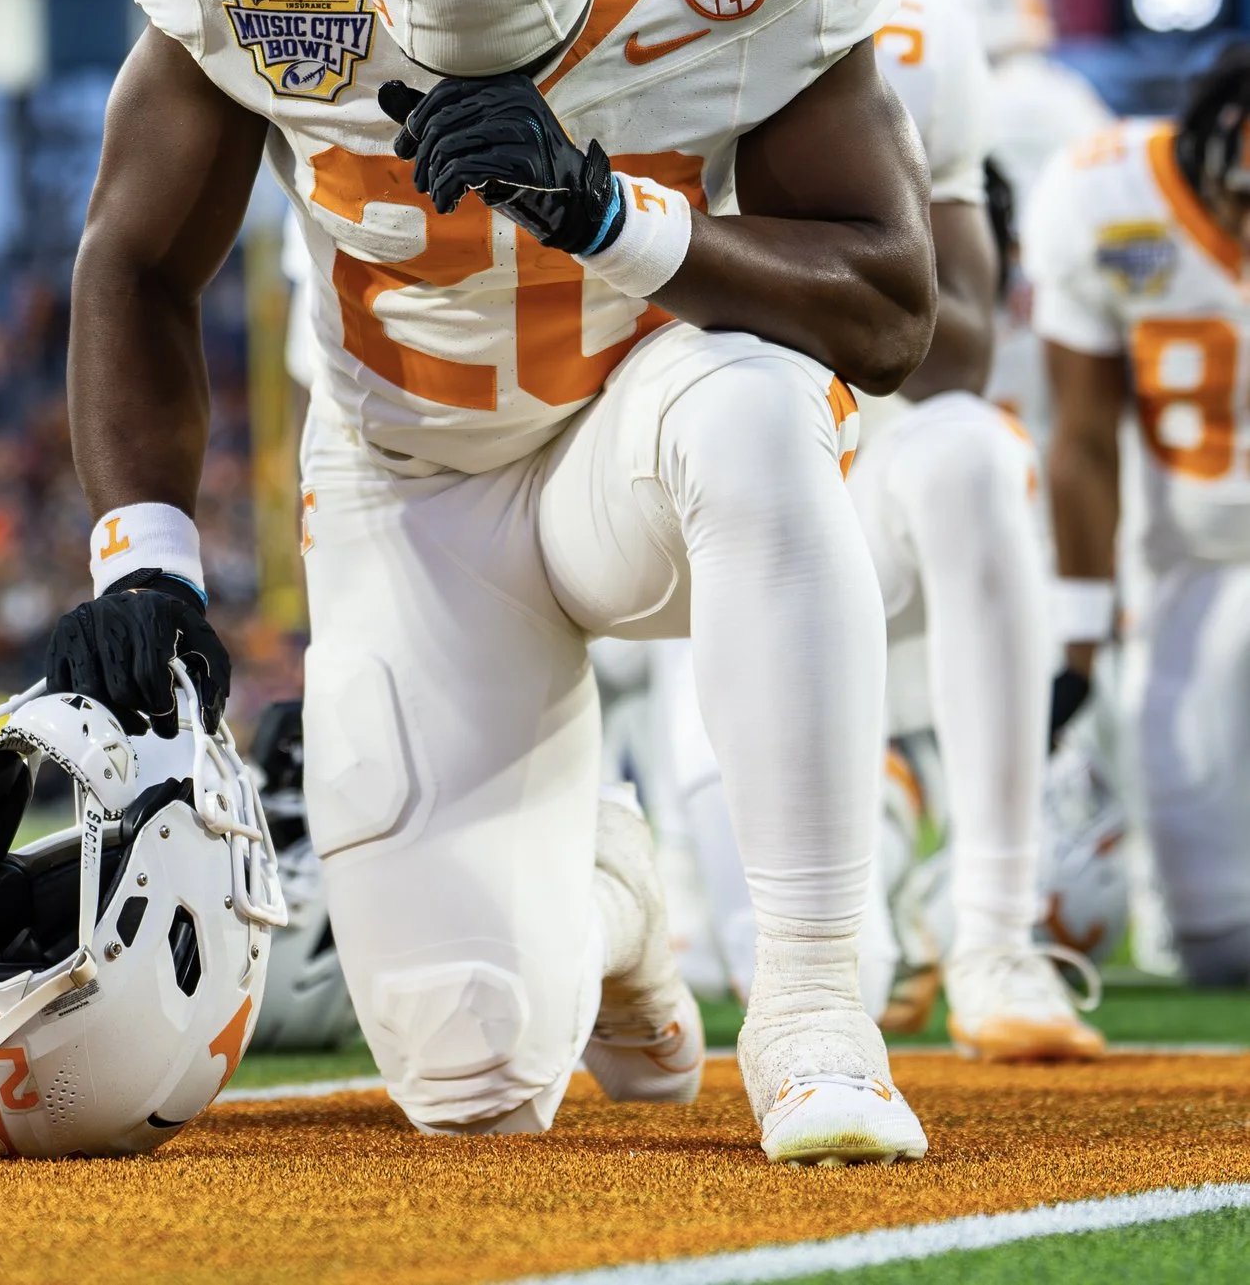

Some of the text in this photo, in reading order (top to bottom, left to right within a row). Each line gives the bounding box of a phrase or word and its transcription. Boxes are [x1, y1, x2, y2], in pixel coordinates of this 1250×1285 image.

[234, 12, 367, 49] MUSIC CITY
[265, 39, 337, 66] BOWL
[631, 184, 667, 215] T
[100, 518, 129, 560] T
